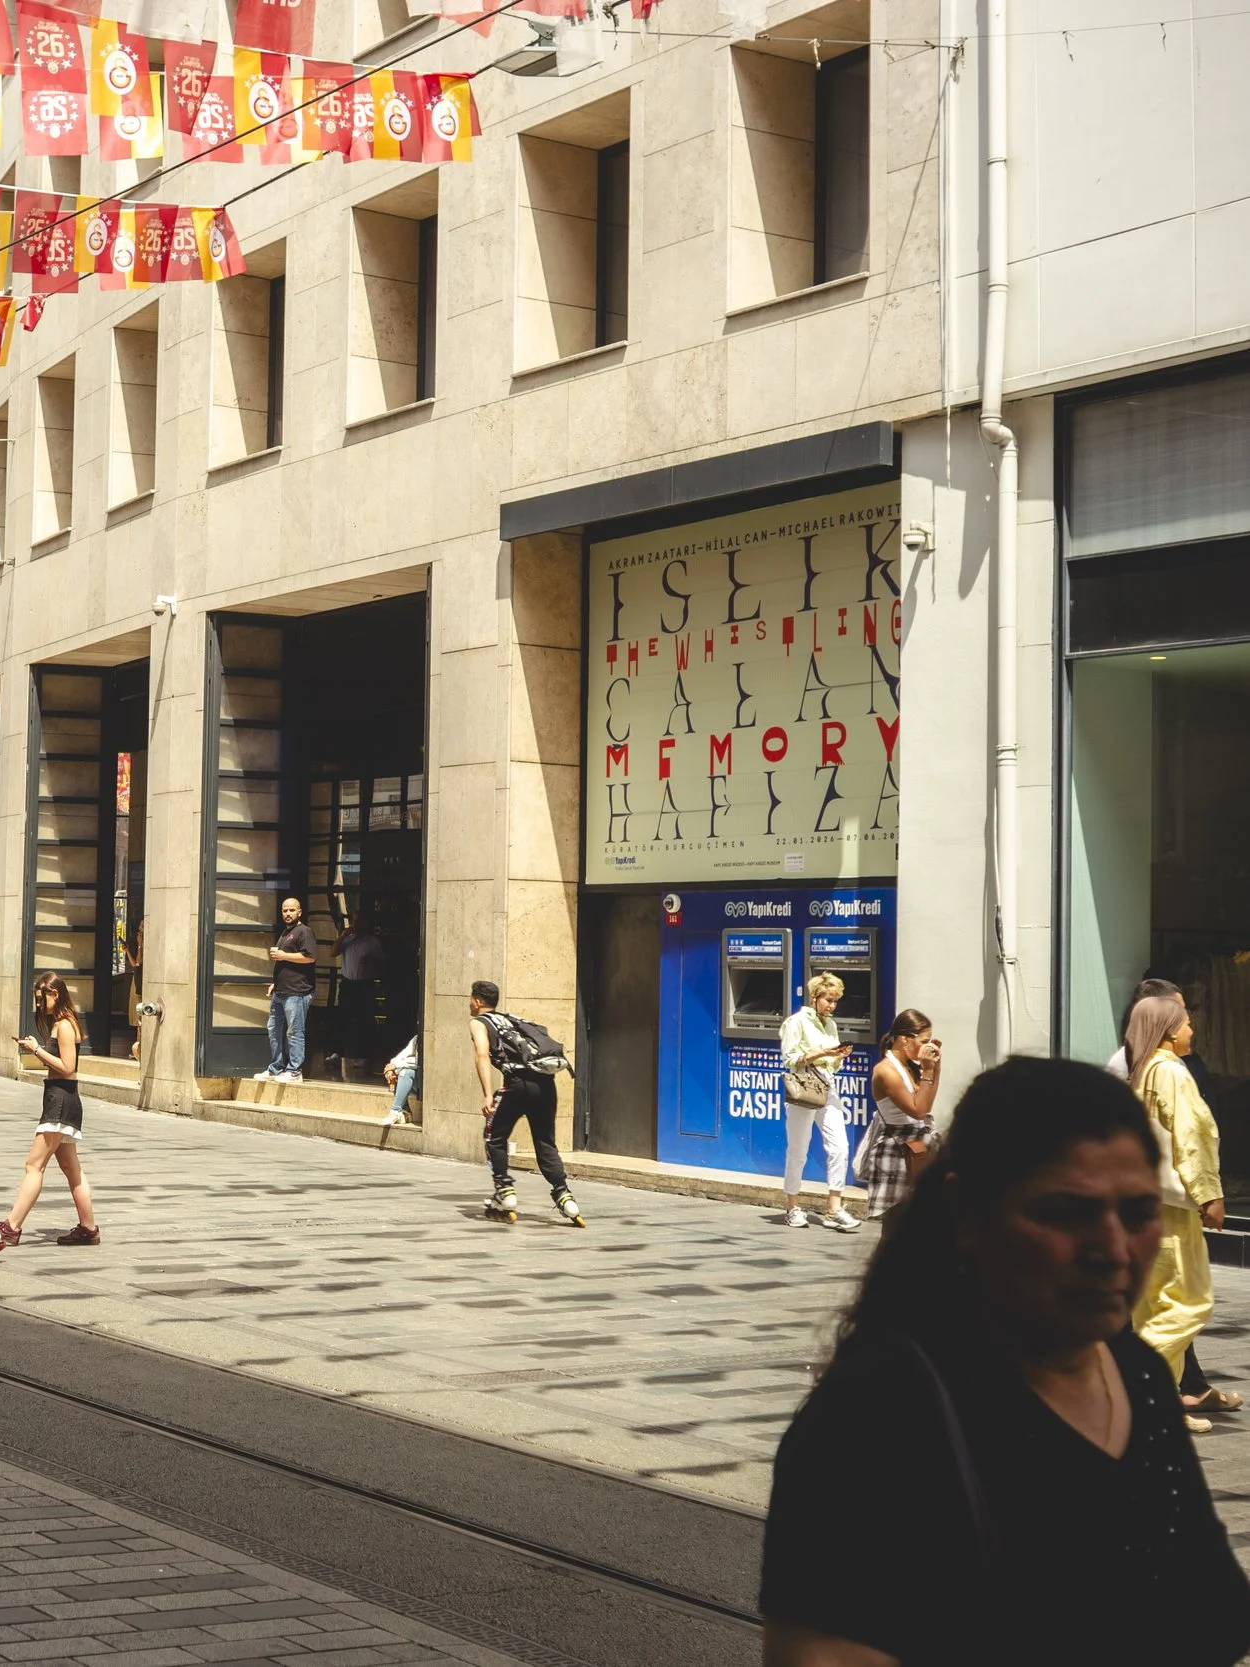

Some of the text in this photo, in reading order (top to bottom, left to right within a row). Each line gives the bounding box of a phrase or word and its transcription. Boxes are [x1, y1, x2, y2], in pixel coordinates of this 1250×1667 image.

[36, 31, 65, 58] 26
[181, 68, 202, 97] 26
[317, 90, 342, 117] 26
[26, 218, 45, 242] 26
[145, 228, 163, 252] 26
[608, 554, 645, 571] AKRAM
[606, 599, 901, 677] THE WHISTLING
[747, 901, 792, 918] YapıKredi
[833, 899, 881, 918] YapıKredi
[730, 1070, 781, 1091] INSTANT
[729, 1090, 781, 1121] CASH
